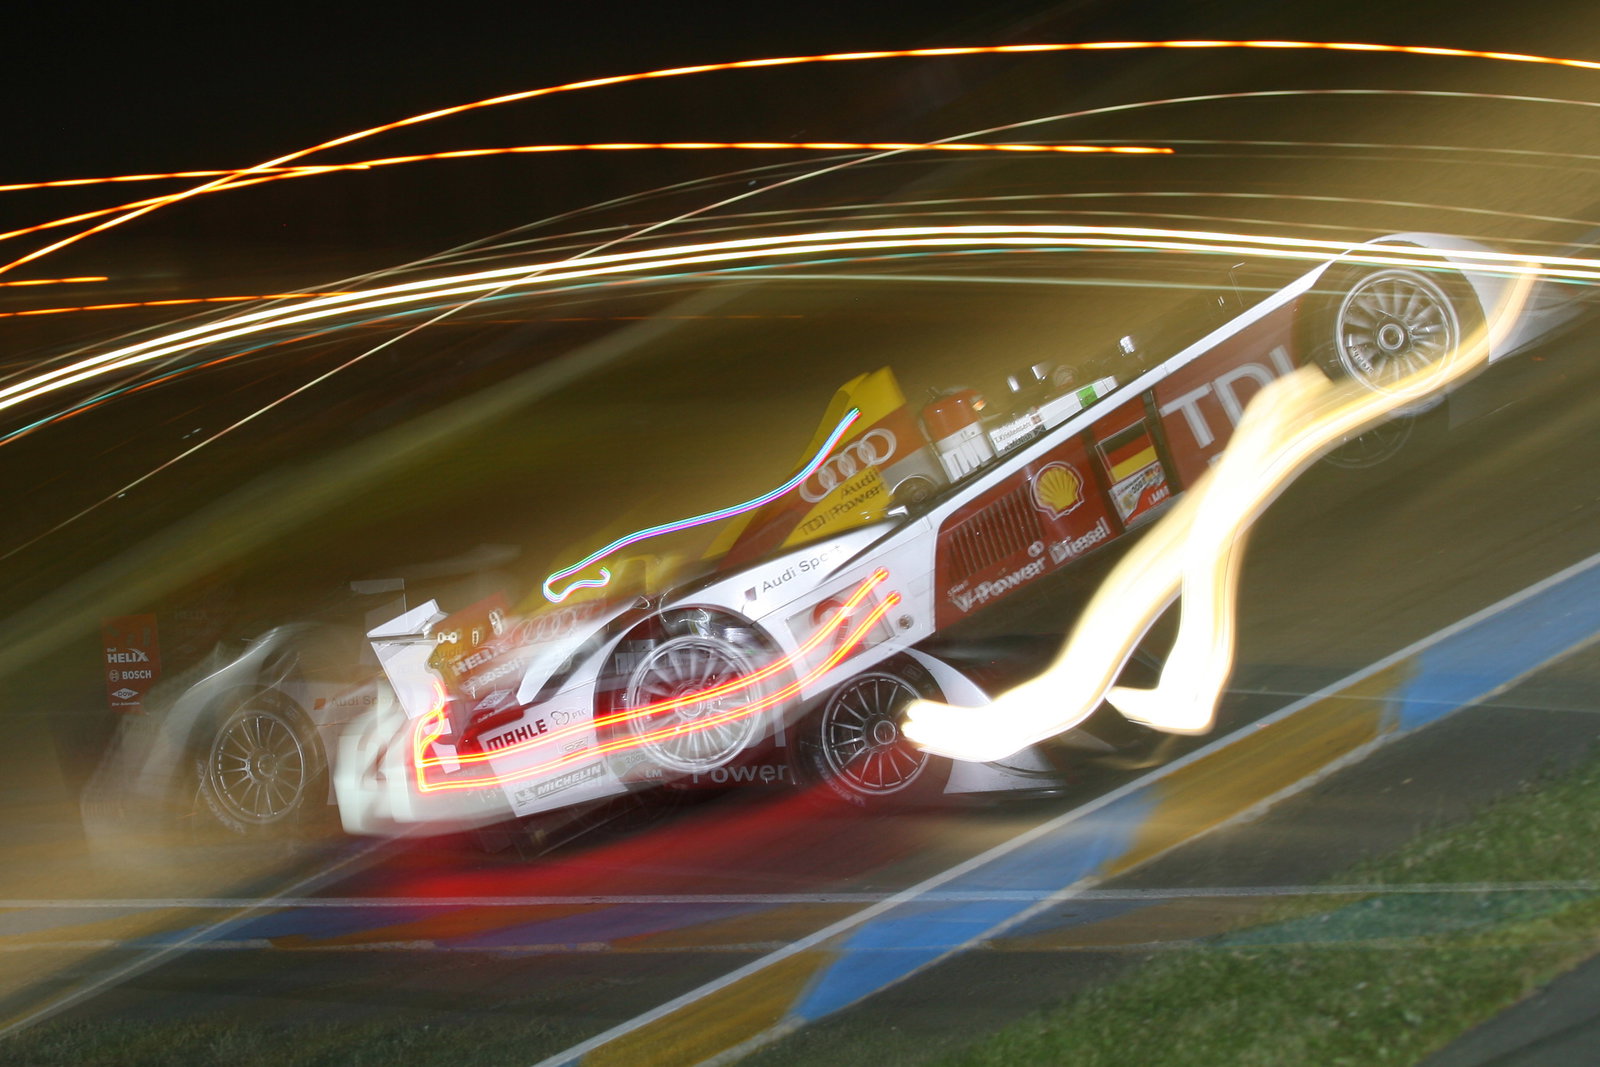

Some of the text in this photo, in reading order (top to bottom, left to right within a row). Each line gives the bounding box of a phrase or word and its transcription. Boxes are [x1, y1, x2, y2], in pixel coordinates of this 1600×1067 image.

[839, 470, 881, 500] Audi
[1049, 516, 1111, 565] Diesel
[762, 566, 797, 594] Audi
[107, 649, 150, 664] HELIX
[122, 670, 152, 680] BOSCH
[486, 719, 549, 750] MAHLE
[537, 762, 602, 795] MICHELIN
